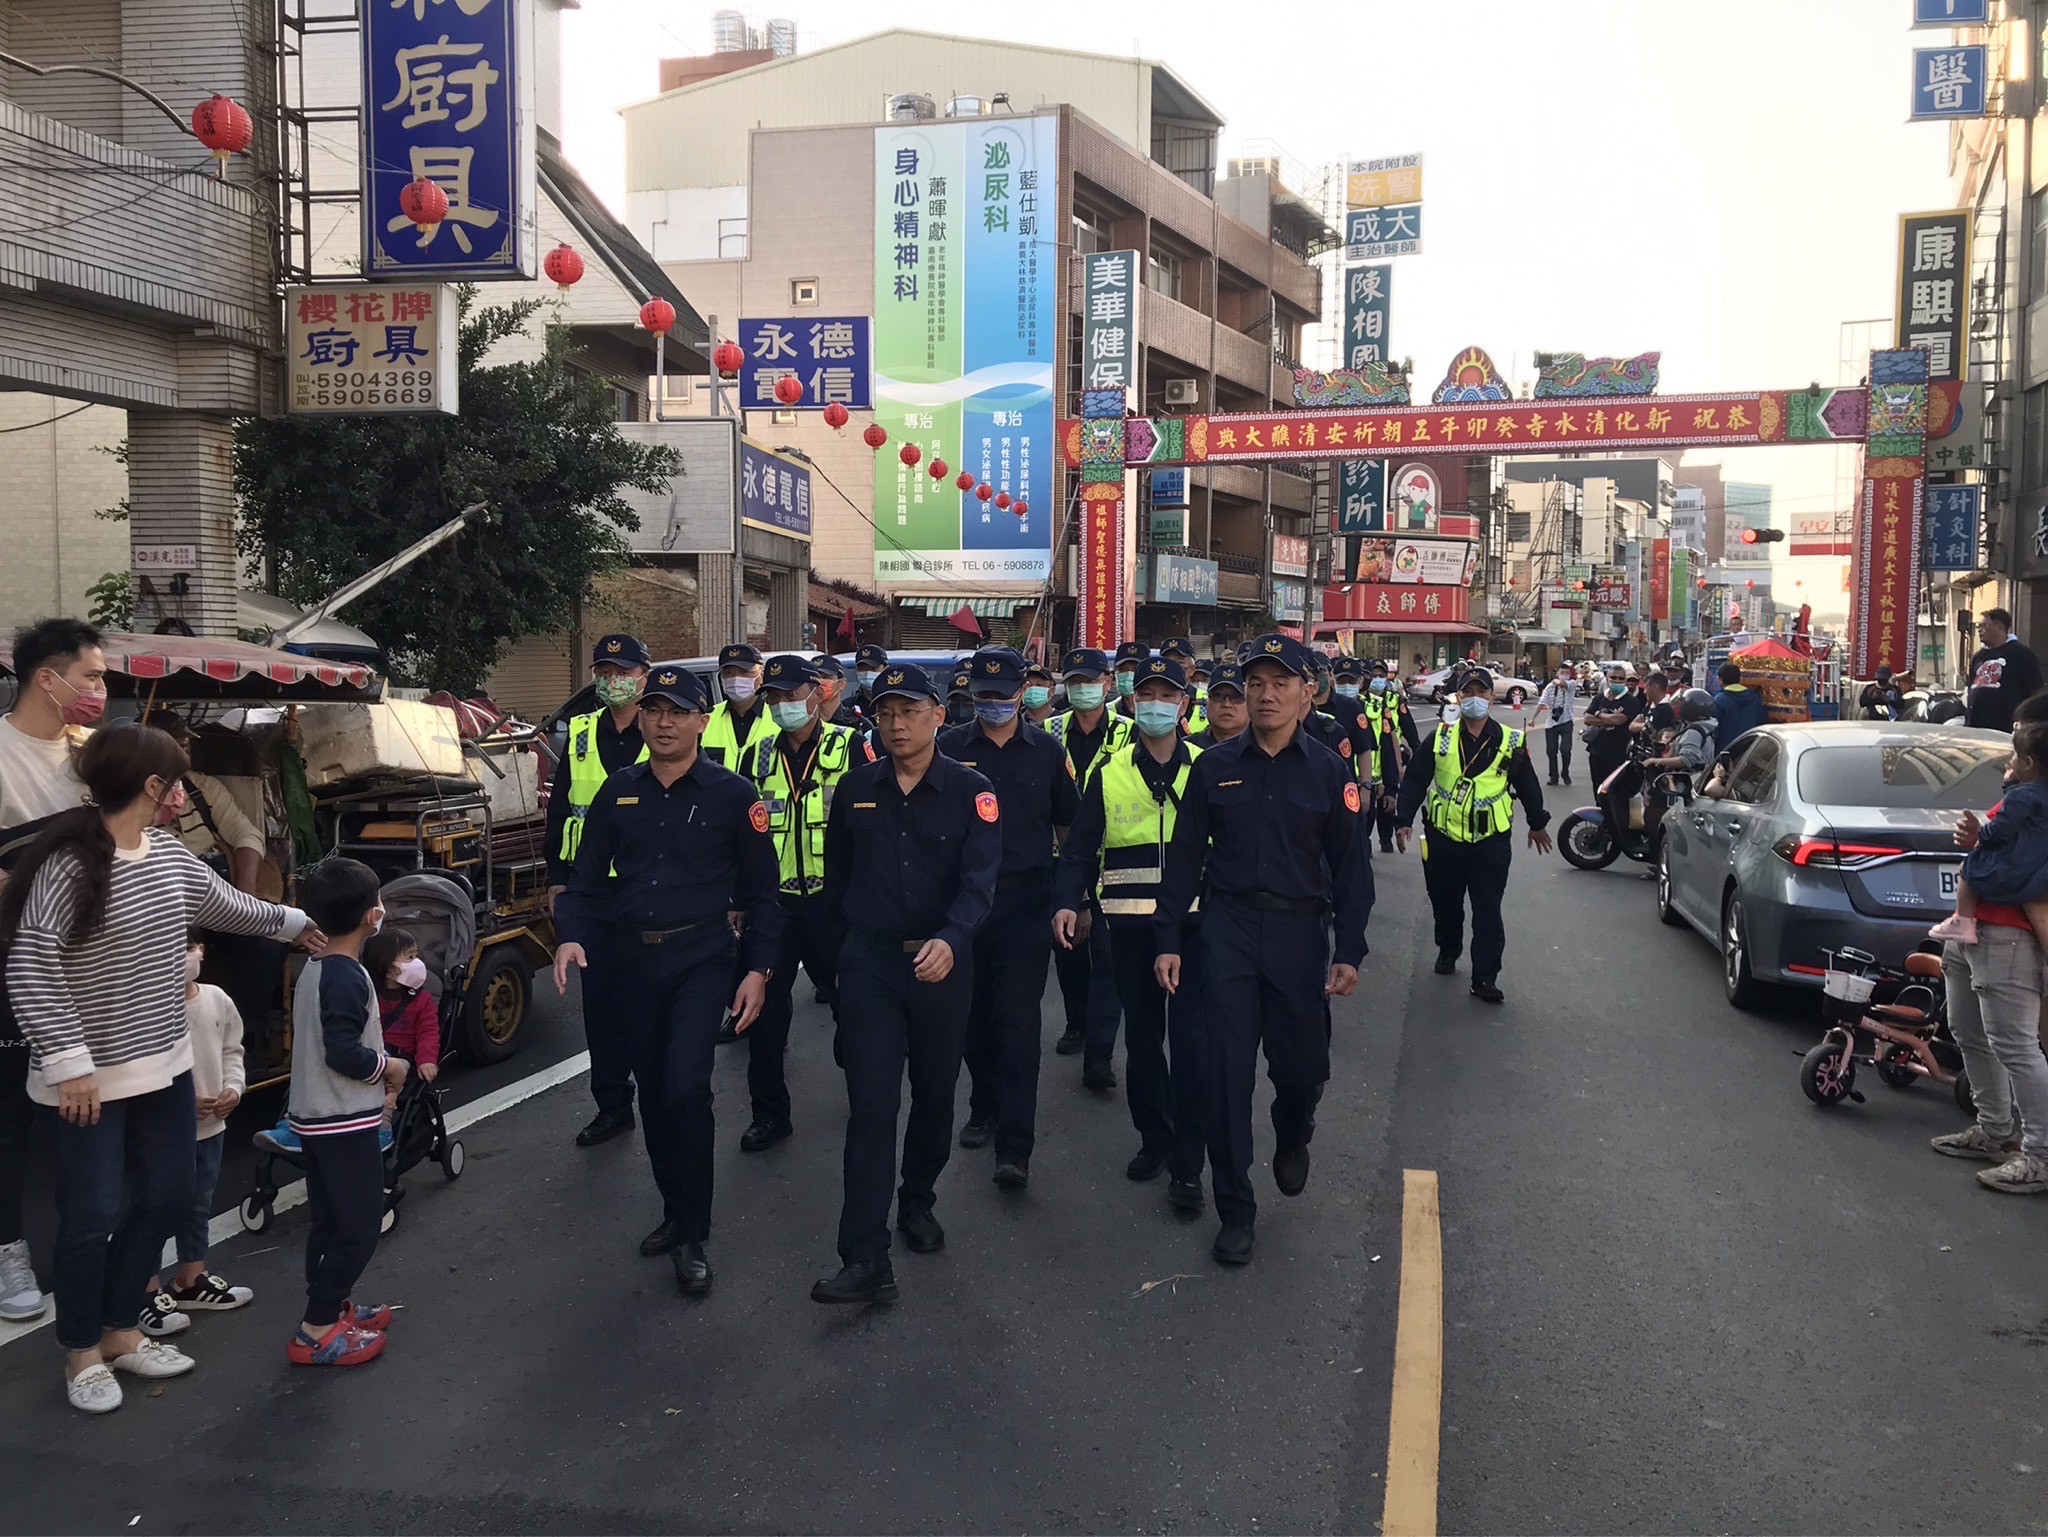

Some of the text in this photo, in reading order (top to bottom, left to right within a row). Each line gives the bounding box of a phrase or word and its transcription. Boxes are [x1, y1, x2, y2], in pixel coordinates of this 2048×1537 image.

[1351, 155, 1418, 173] 本院附設
[983, 141, 1011, 233] 泌尿科
[1018, 170, 1038, 236] 藍仕凱
[1351, 172, 1416, 203] 洗腎
[893, 147, 920, 302] 身心精神科
[1351, 210, 1416, 243] 成大
[1350, 241, 1417, 258] 主治醫師
[297, 291, 433, 324] 櫻花牌
[1090, 255, 1127, 387] 美華健保
[1351, 270, 1384, 369] 陳相國
[753, 322, 855, 360] 永德
[317, 371, 433, 388] 5904369
[317, 388, 433, 405] 5905669
[753, 367, 855, 403] 電信
[904, 412, 934, 429] 專治
[993, 410, 1023, 428] 專治
[1930, 444, 1976, 467] 中醫
[742, 456, 809, 518] 永德電信
[981, 437, 991, 524] 男女泌尿疾病
[1001, 437, 1011, 512] 男性性功能
[1020, 436, 1030, 534] 男性泌尿科門手術
[1345, 459, 1379, 526] 診所
[1946, 490, 1971, 565] 針灸科
[962, 561, 980, 571] TEL
[1004, 560, 1045, 571] 5908878
